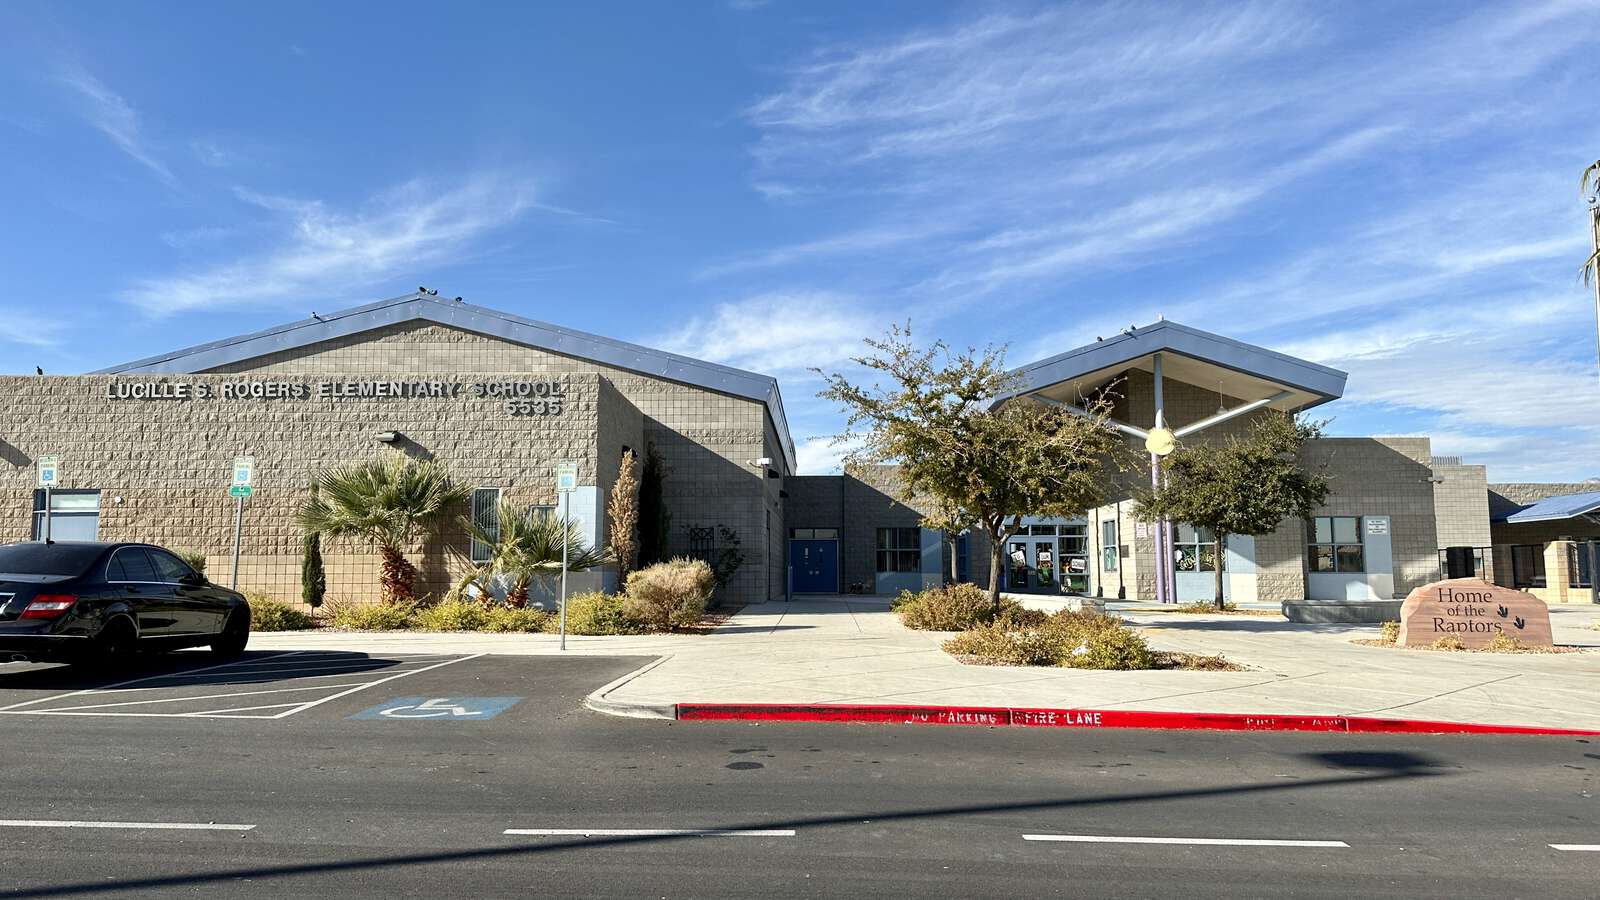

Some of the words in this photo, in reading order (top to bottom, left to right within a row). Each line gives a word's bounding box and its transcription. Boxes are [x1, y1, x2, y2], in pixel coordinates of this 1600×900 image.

[106, 382, 188, 399] LUCILLE
[195, 382, 213, 398] S.
[222, 382, 304, 397] ROGERS
[318, 381, 460, 397] ELEMENTARY
[473, 381, 561, 396] SCHOOL
[505, 399, 561, 415] 5535
[1438, 588, 1492, 603] Home
[1447, 604, 1459, 616] of
[1465, 605, 1485, 616] the
[1432, 617, 1502, 633] Raptors
[1025, 712, 1056, 724] FIRE
[1066, 712, 1102, 724] LANE
